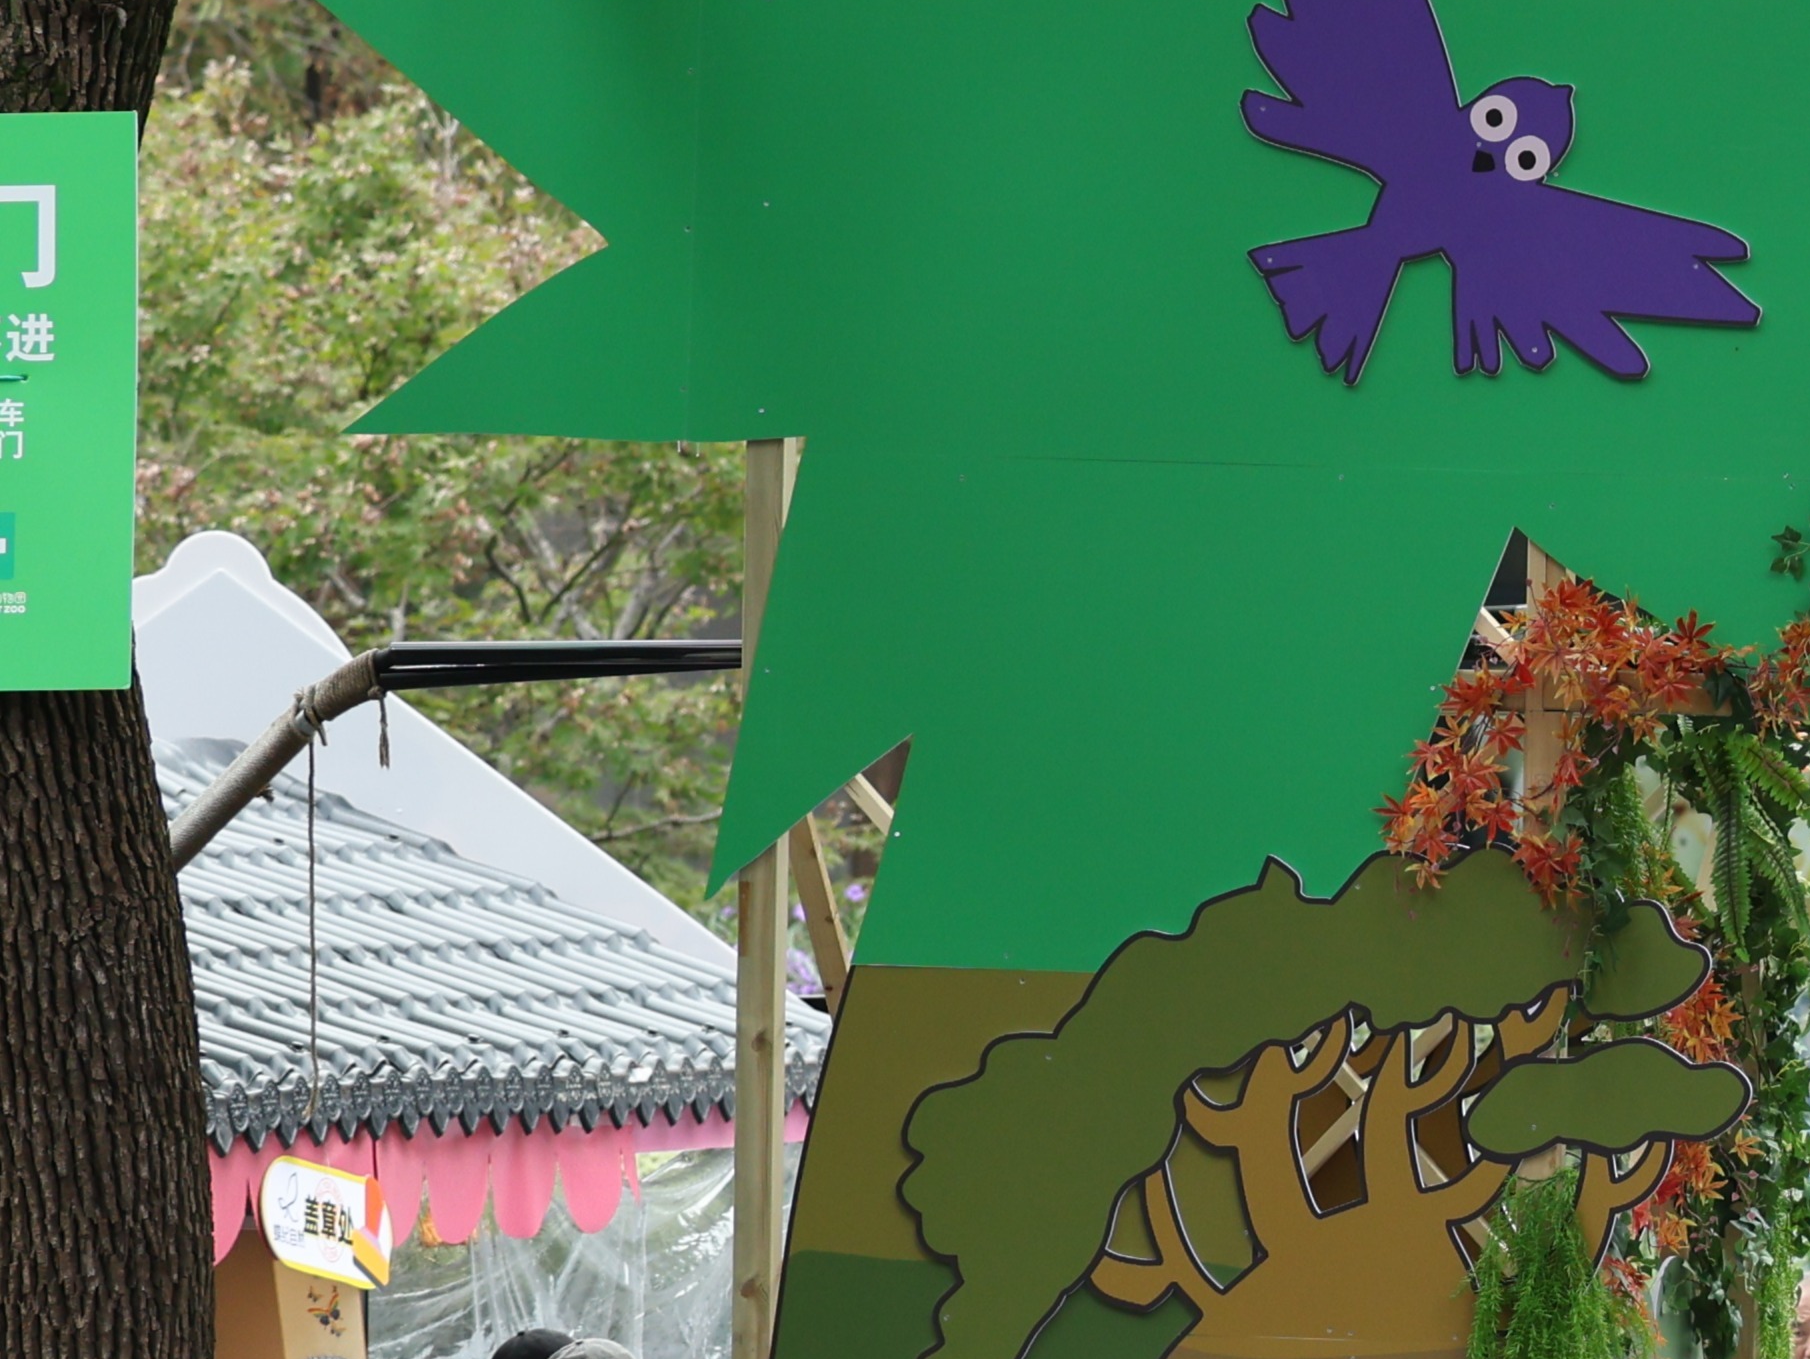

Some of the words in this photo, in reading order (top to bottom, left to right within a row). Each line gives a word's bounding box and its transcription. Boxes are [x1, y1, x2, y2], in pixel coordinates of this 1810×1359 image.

[6, 313, 54, 362] 进
[303, 1194, 355, 1246] 盖章处
